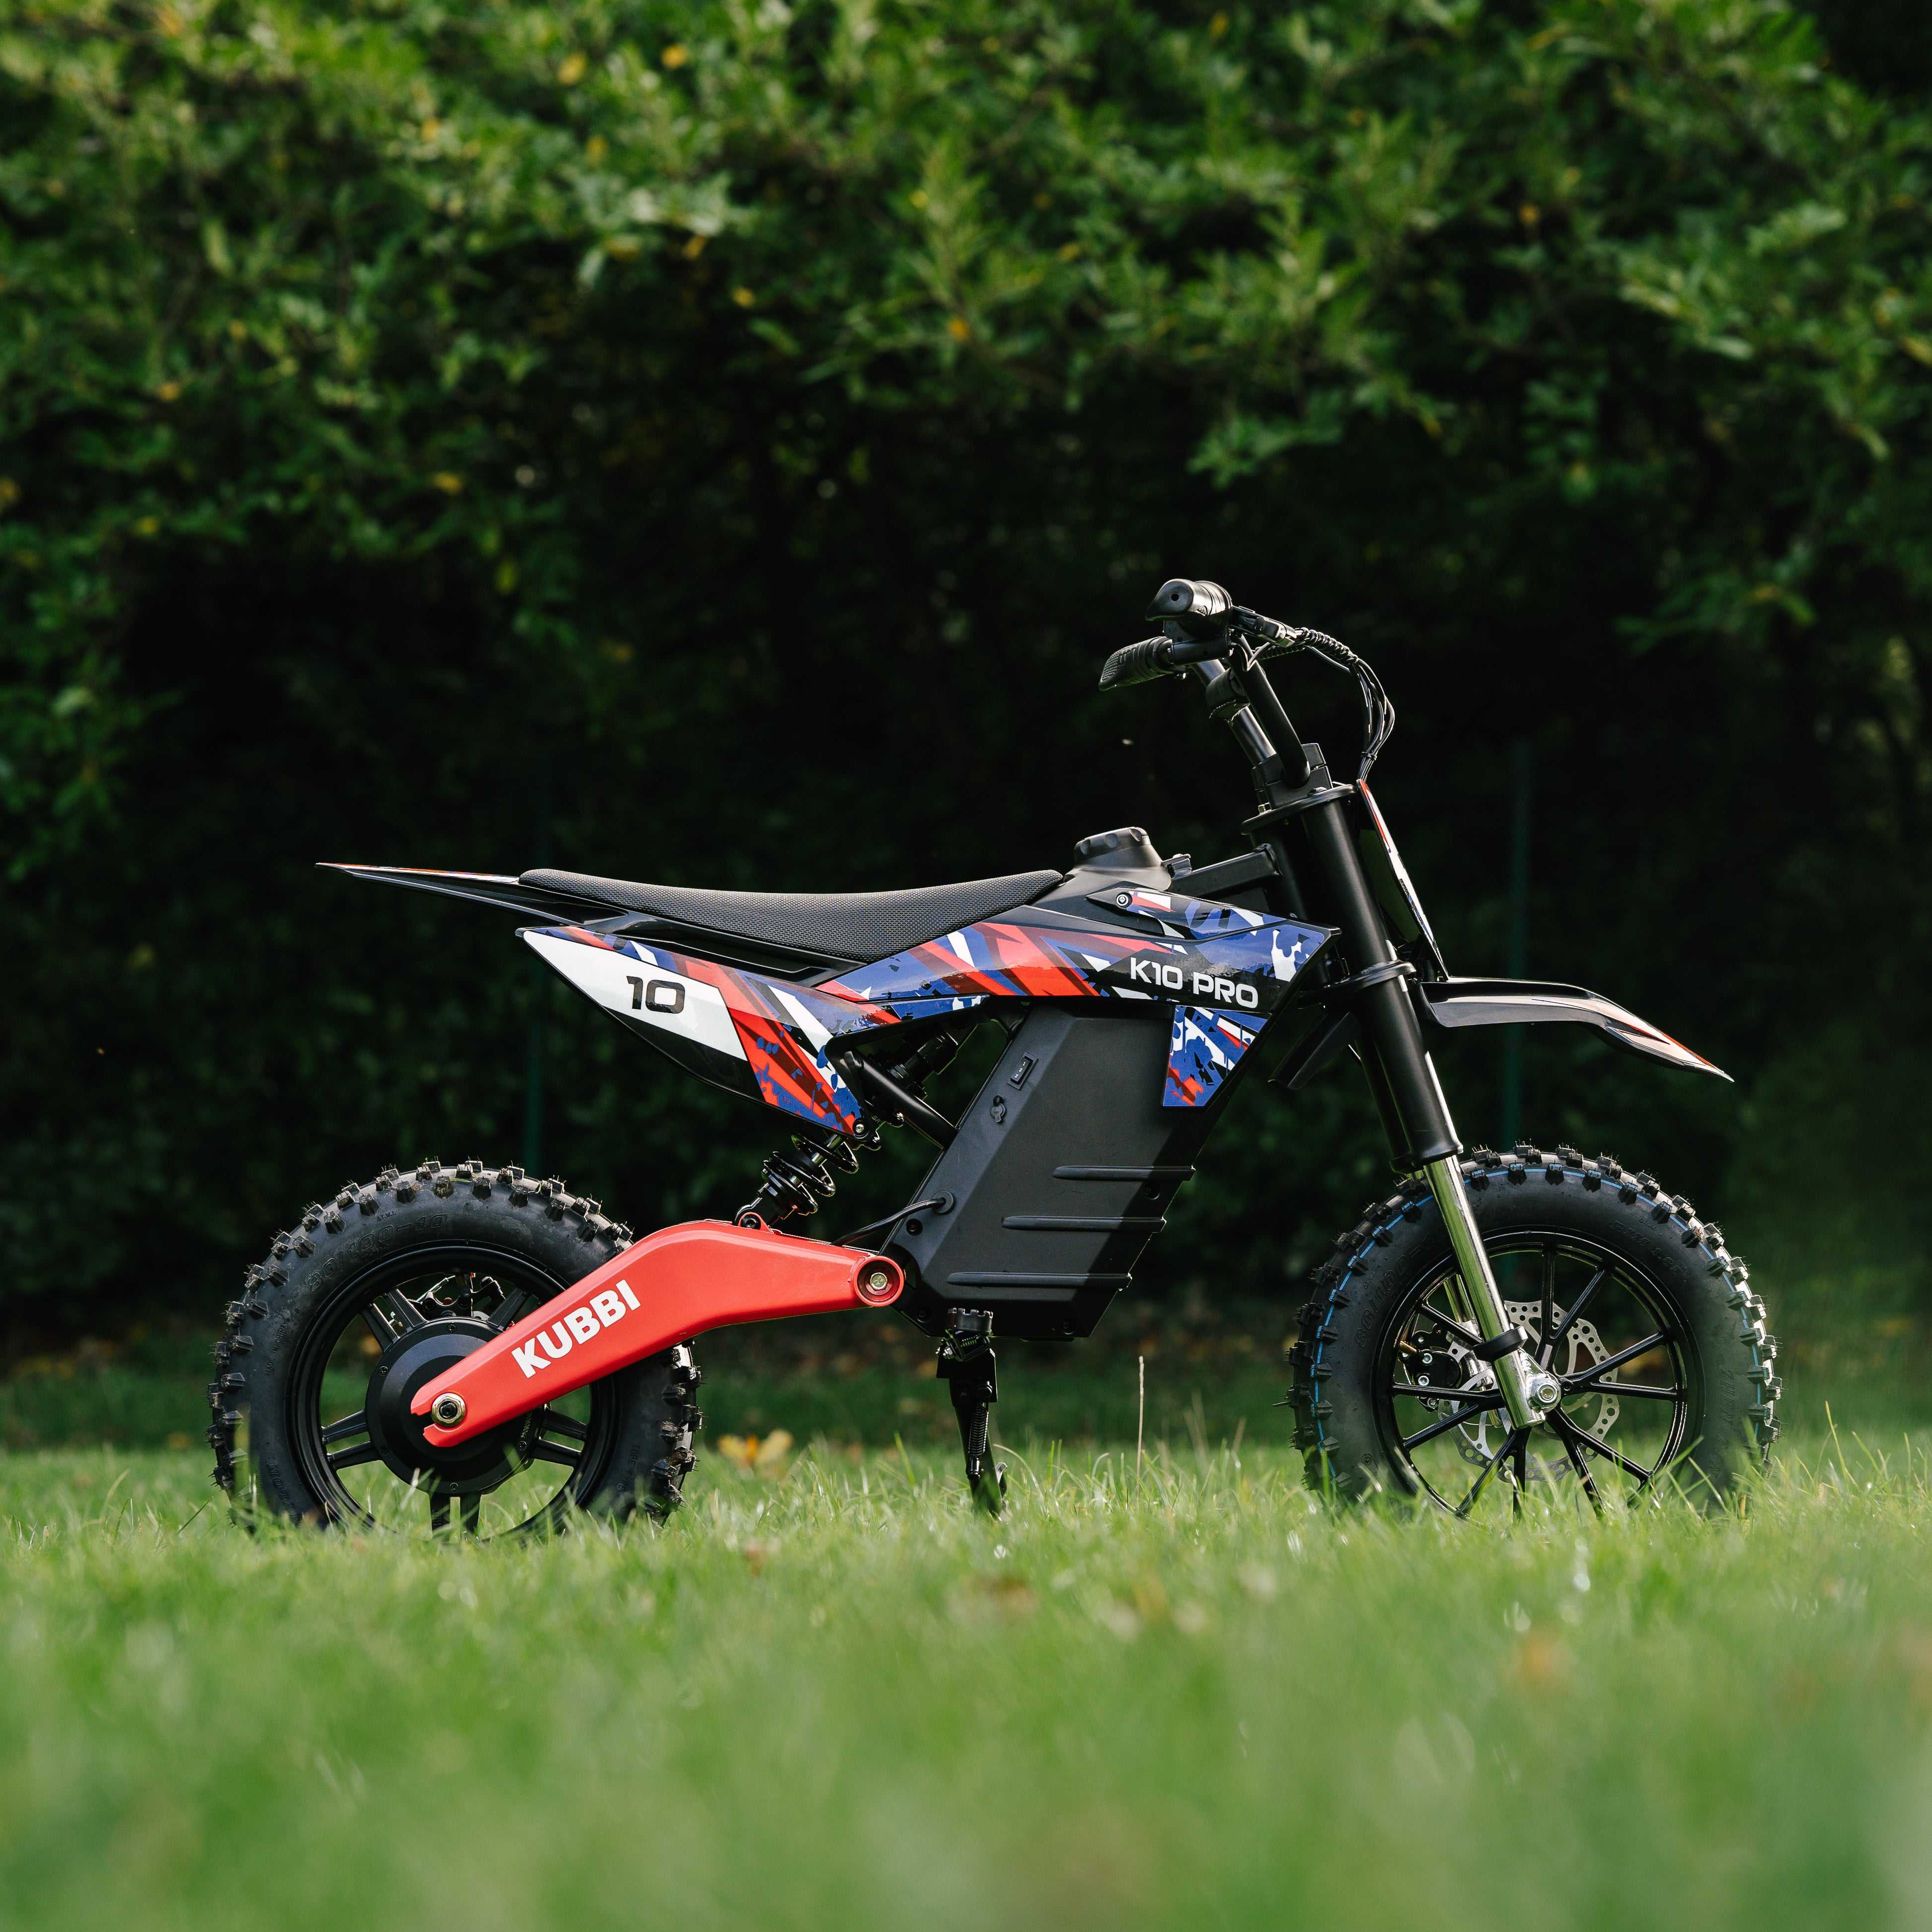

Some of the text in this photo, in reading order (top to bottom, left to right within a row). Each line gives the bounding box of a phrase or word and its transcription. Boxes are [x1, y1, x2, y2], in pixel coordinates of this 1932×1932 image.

[626, 975, 686, 1015] 10
[1130, 956, 1259, 1009] K10 PRO
[306, 1213, 447, 1292] 80/100-10
[511, 1279, 641, 1379] KUBBI
